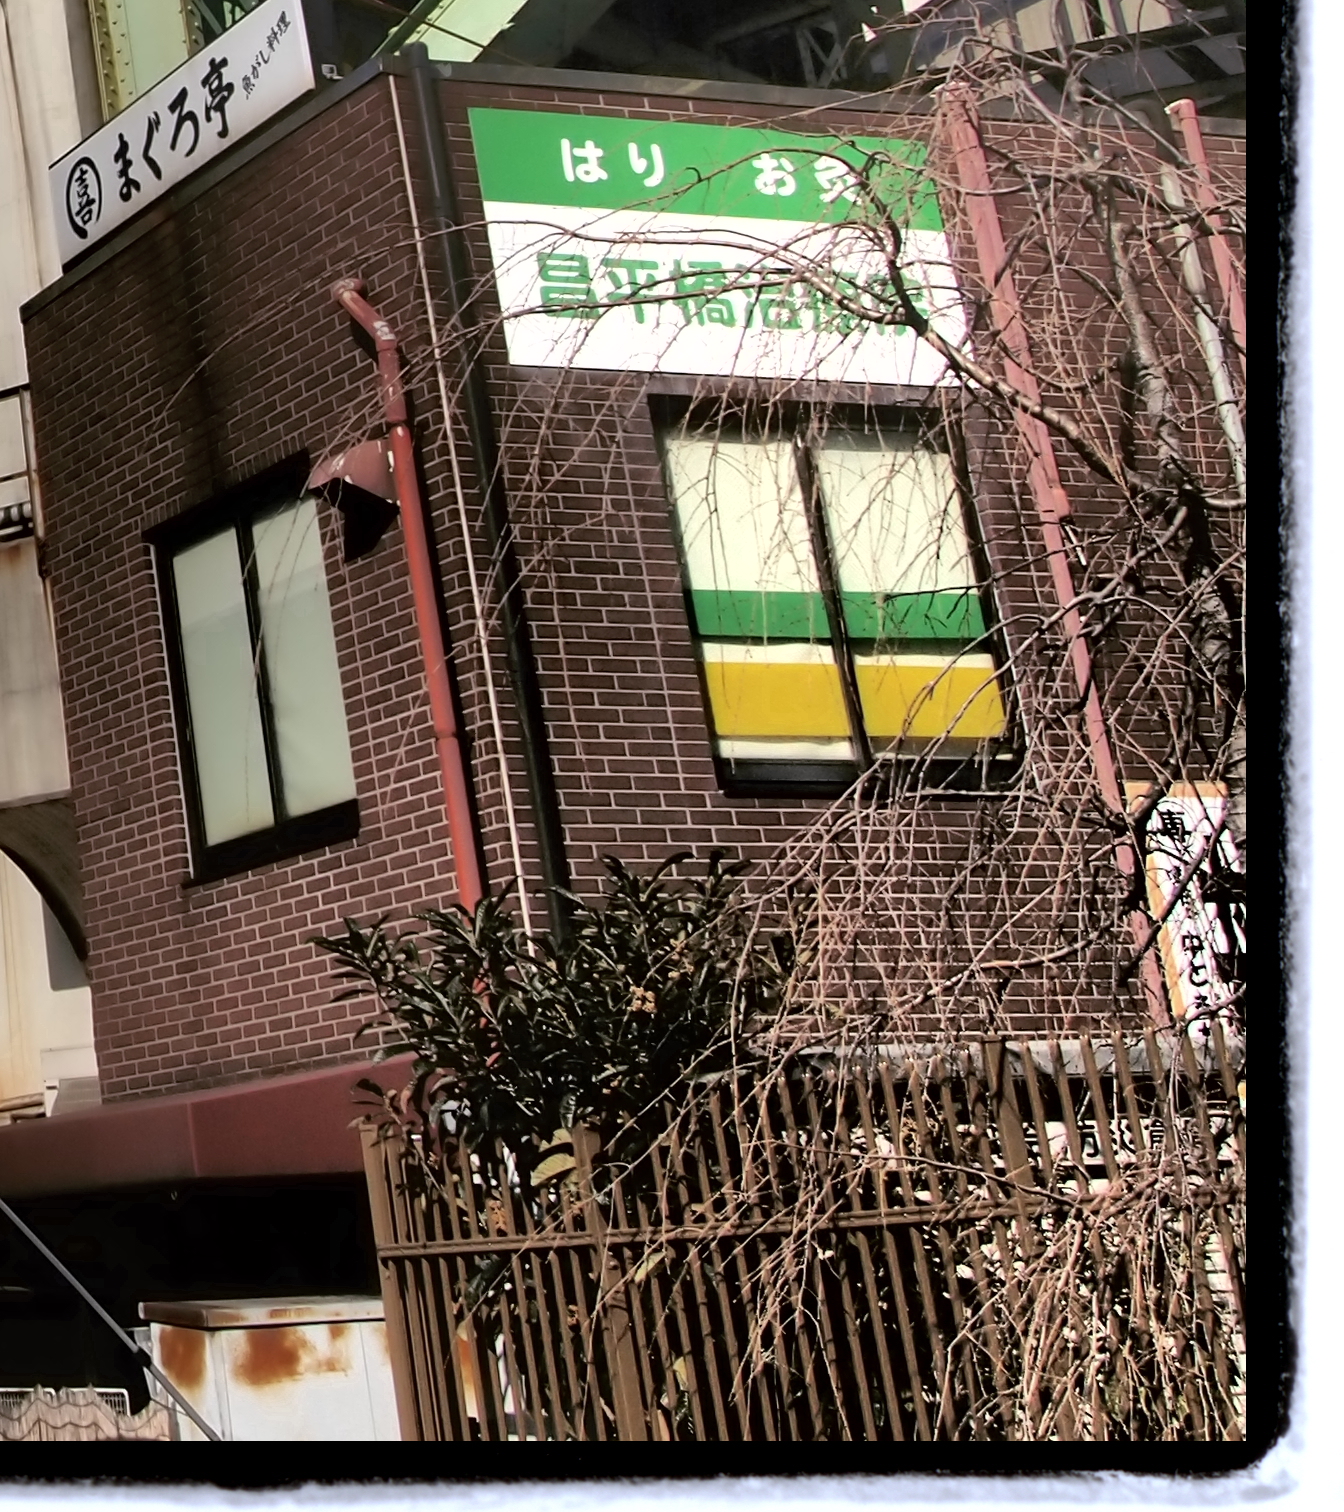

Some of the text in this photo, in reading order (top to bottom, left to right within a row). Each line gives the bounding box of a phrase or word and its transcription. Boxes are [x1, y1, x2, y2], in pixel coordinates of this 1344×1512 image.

[114, 57, 235, 203] まぐろ亭
[560, 138, 664, 187] はり
